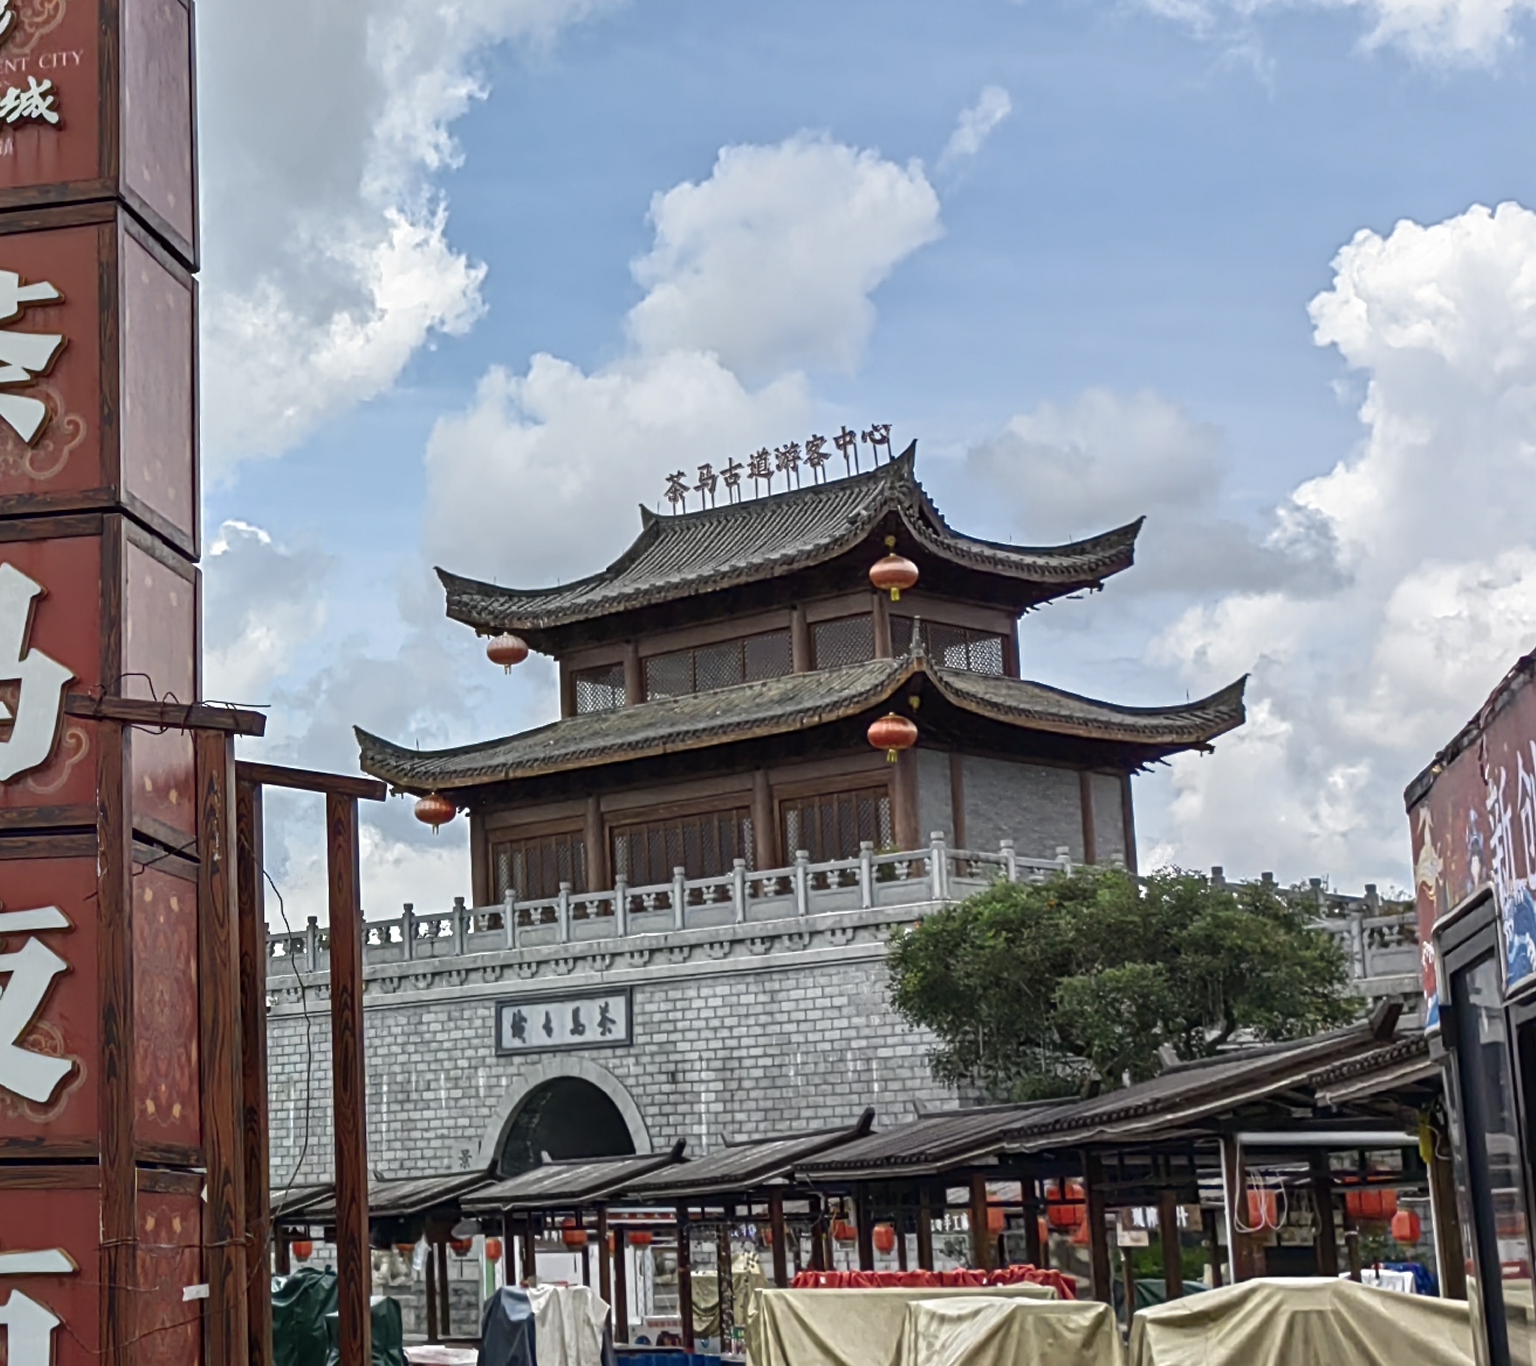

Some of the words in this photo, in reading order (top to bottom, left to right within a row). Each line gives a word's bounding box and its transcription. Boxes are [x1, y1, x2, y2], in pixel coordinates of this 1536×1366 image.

[37, 50, 84, 69] CITY
[664, 423, 893, 505] 茶马古道游客中心
